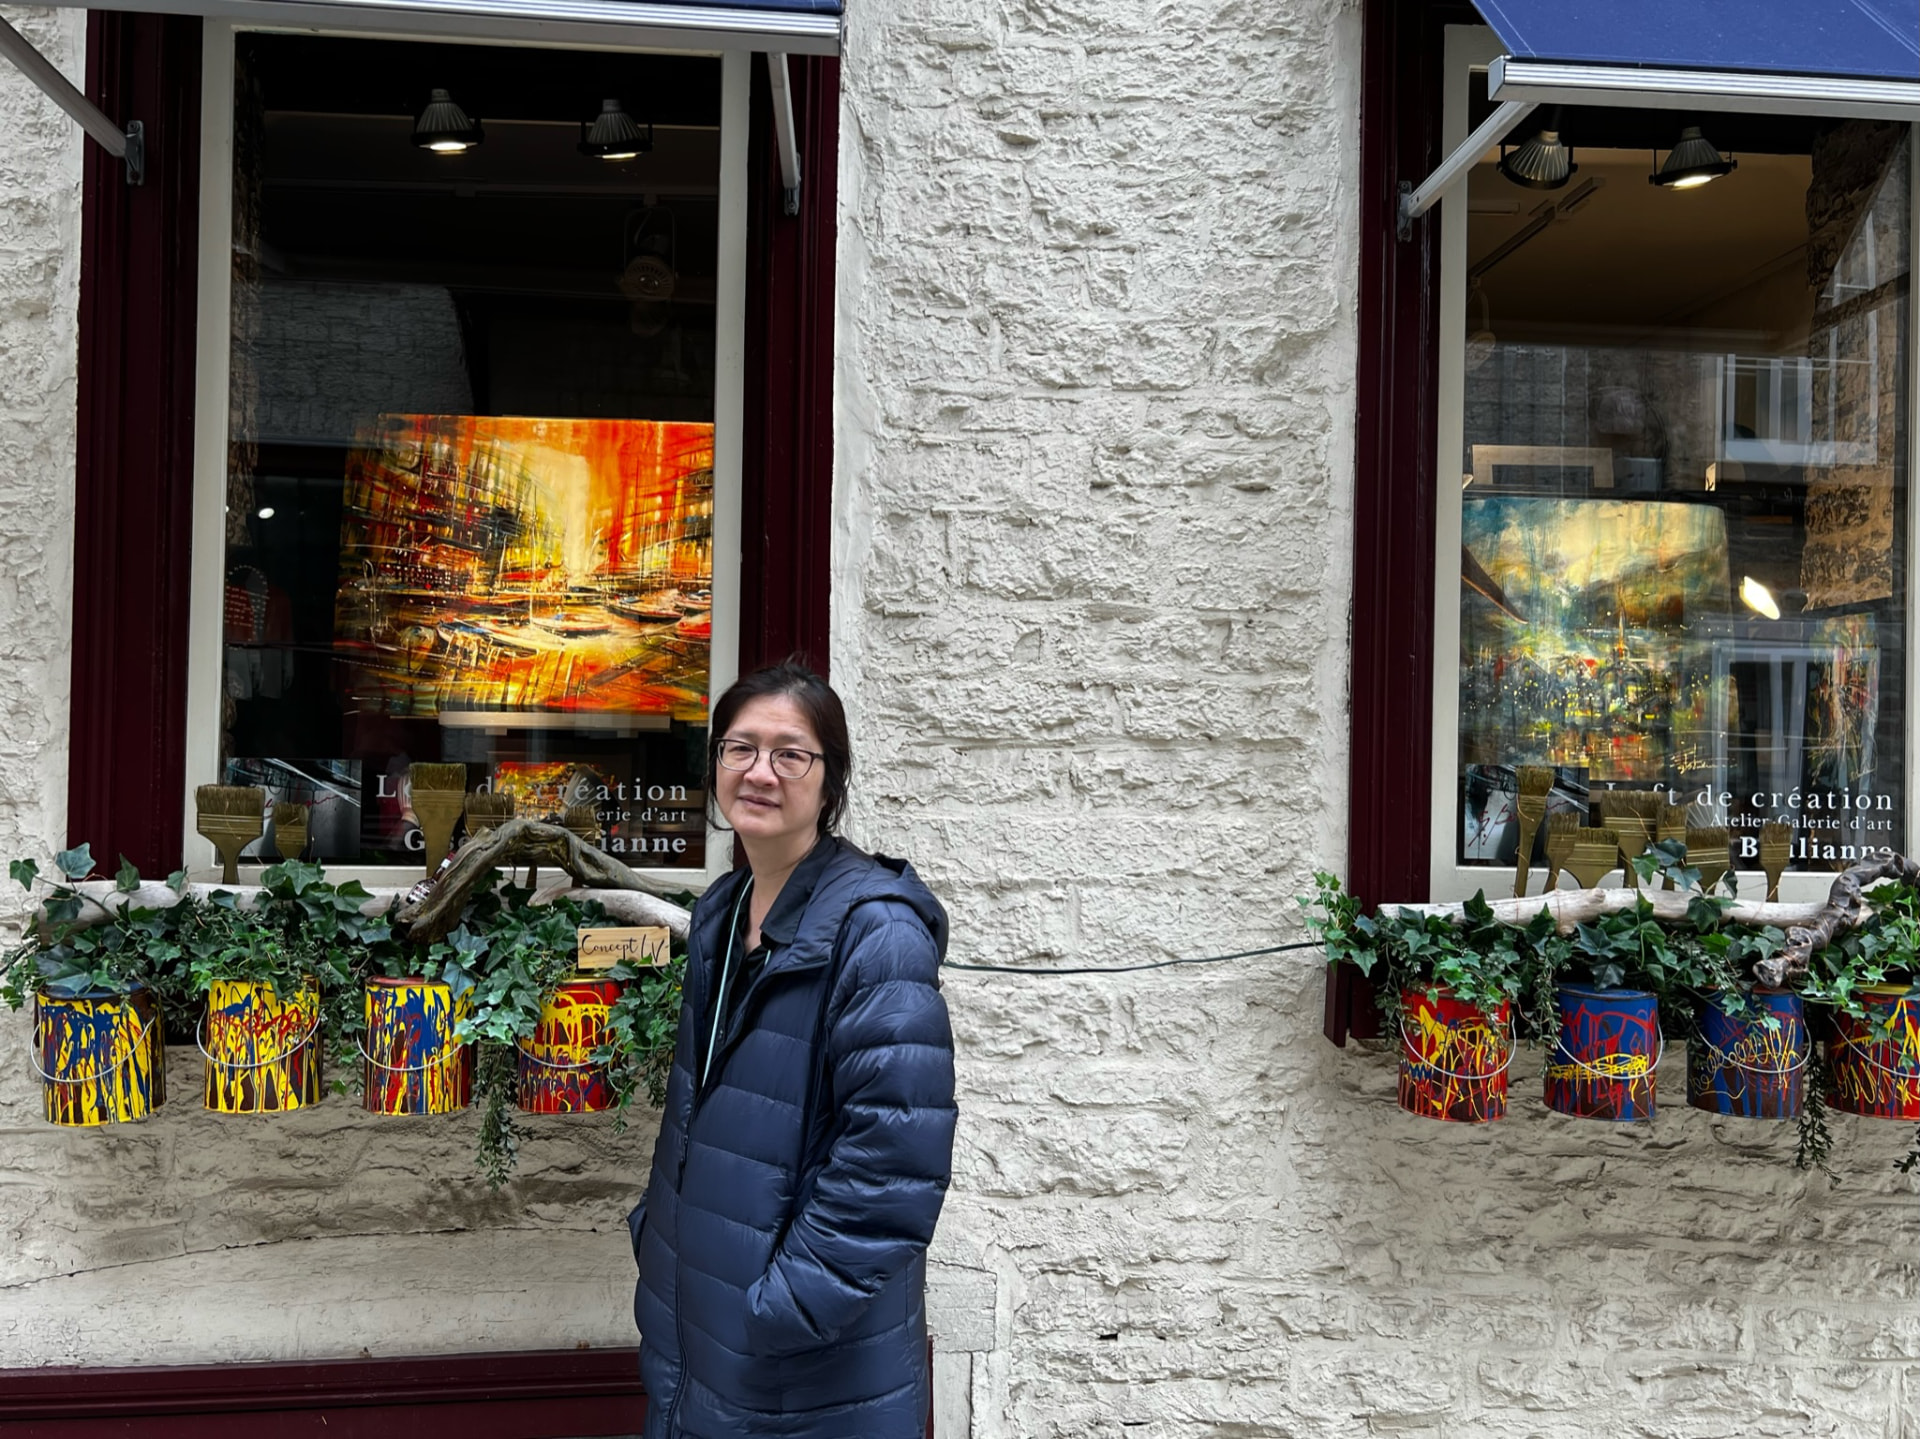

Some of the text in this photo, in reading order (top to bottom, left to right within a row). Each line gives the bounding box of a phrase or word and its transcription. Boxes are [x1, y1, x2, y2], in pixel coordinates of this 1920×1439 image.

[535, 776, 687, 801] création
[1697, 784, 1733, 807] de
[1751, 786, 1893, 810] création
[641, 807, 687, 822] d'art
[1850, 816, 1893, 831] d'art
[600, 829, 687, 853] ianne
[581, 934, 639, 961] Concept
